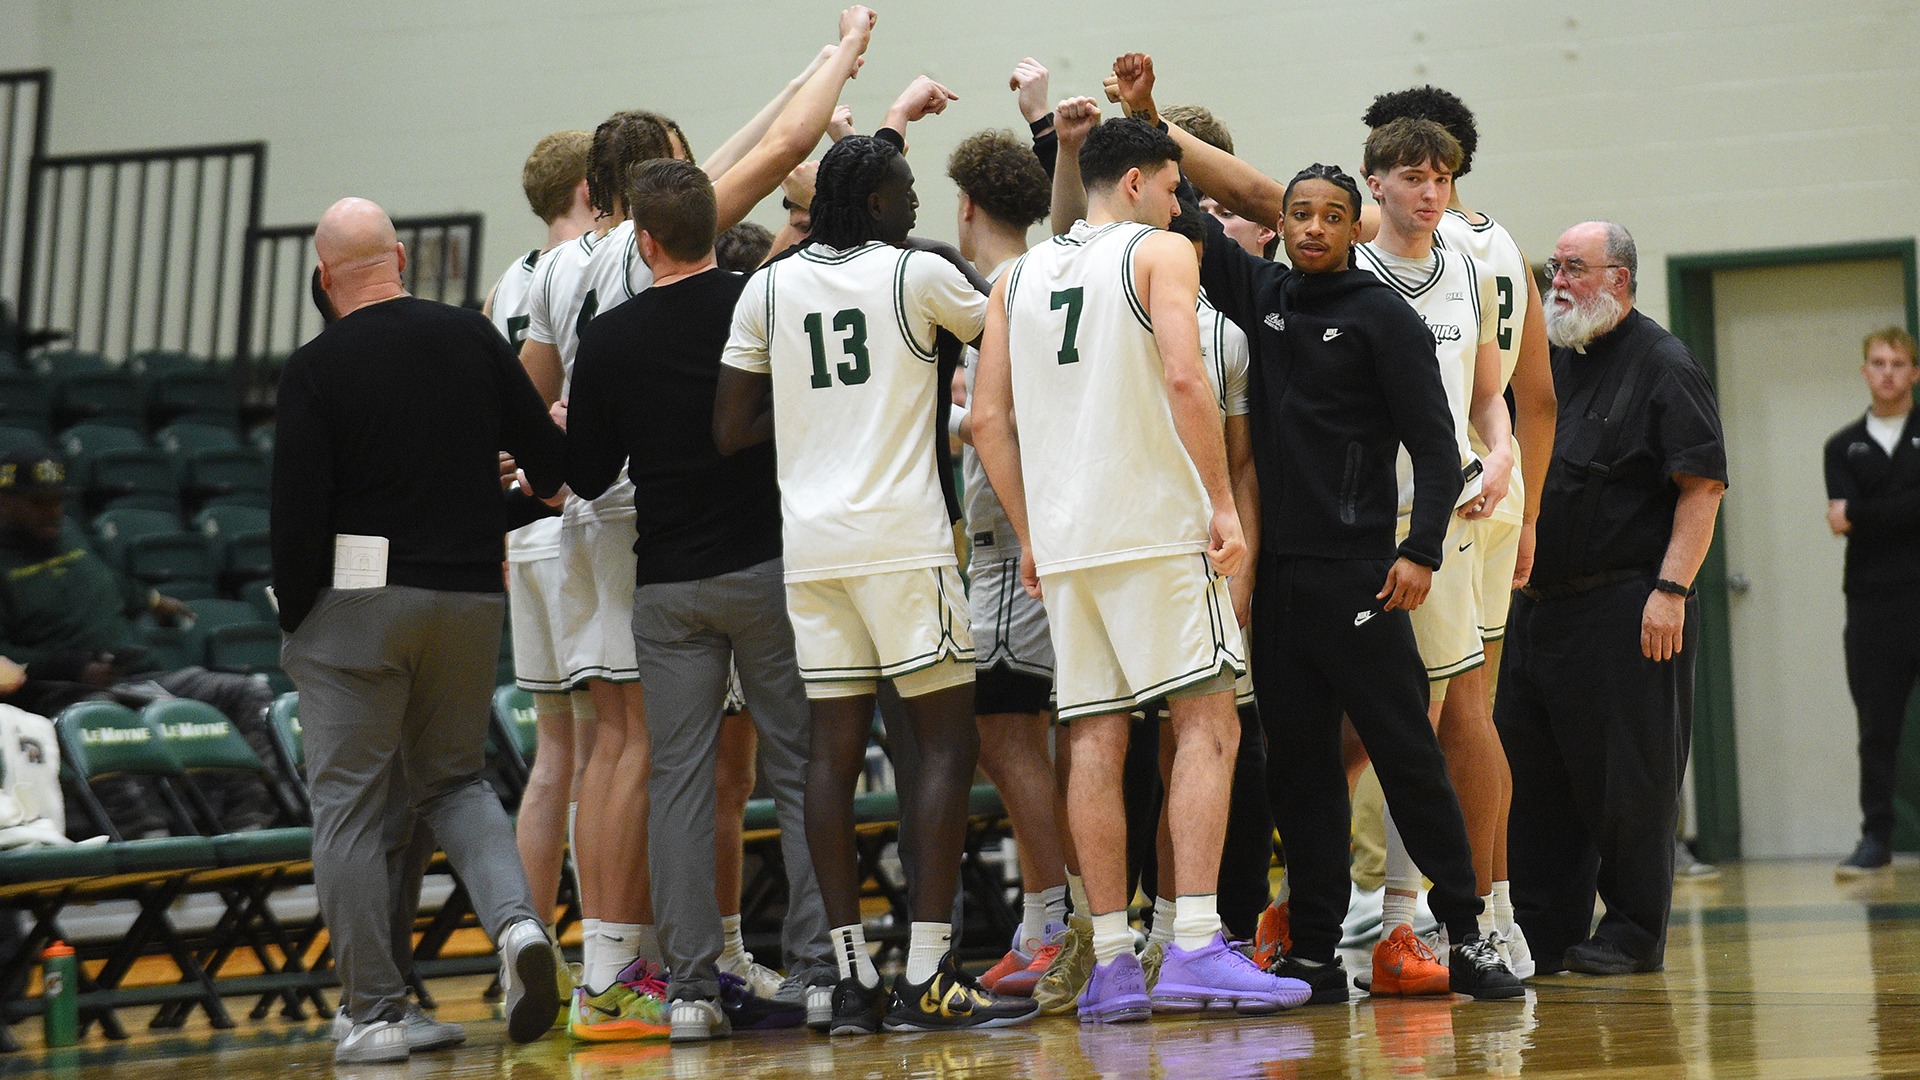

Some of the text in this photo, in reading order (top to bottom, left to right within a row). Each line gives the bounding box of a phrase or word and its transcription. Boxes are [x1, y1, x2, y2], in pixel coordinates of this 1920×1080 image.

[804, 308, 871, 388] 13
[1050, 286, 1083, 365] 7
[671, 1006, 705, 1022] NIKE
